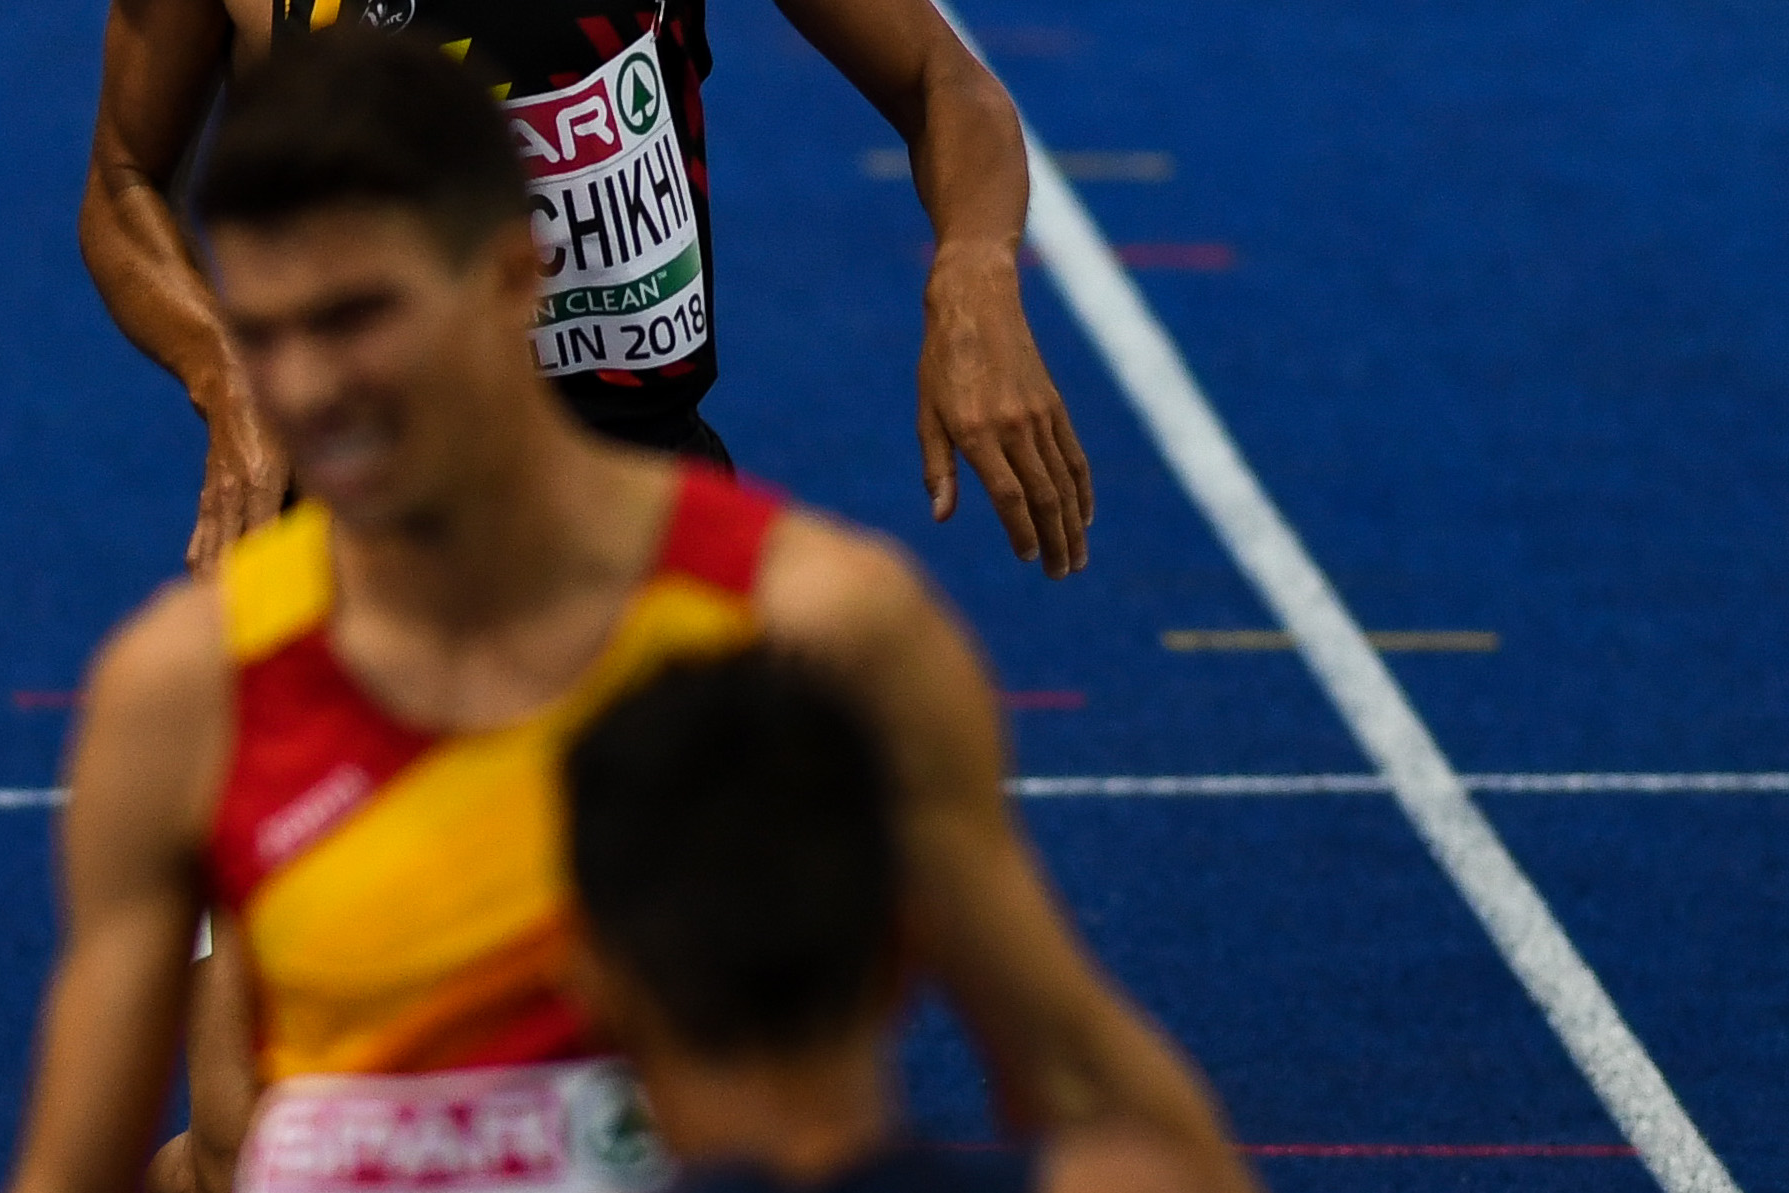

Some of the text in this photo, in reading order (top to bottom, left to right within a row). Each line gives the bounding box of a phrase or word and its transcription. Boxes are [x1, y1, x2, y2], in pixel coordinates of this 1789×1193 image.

[510, 95, 614, 163] AR
[527, 133, 688, 278] CHIKHI
[533, 293, 705, 371] LIN 2018
